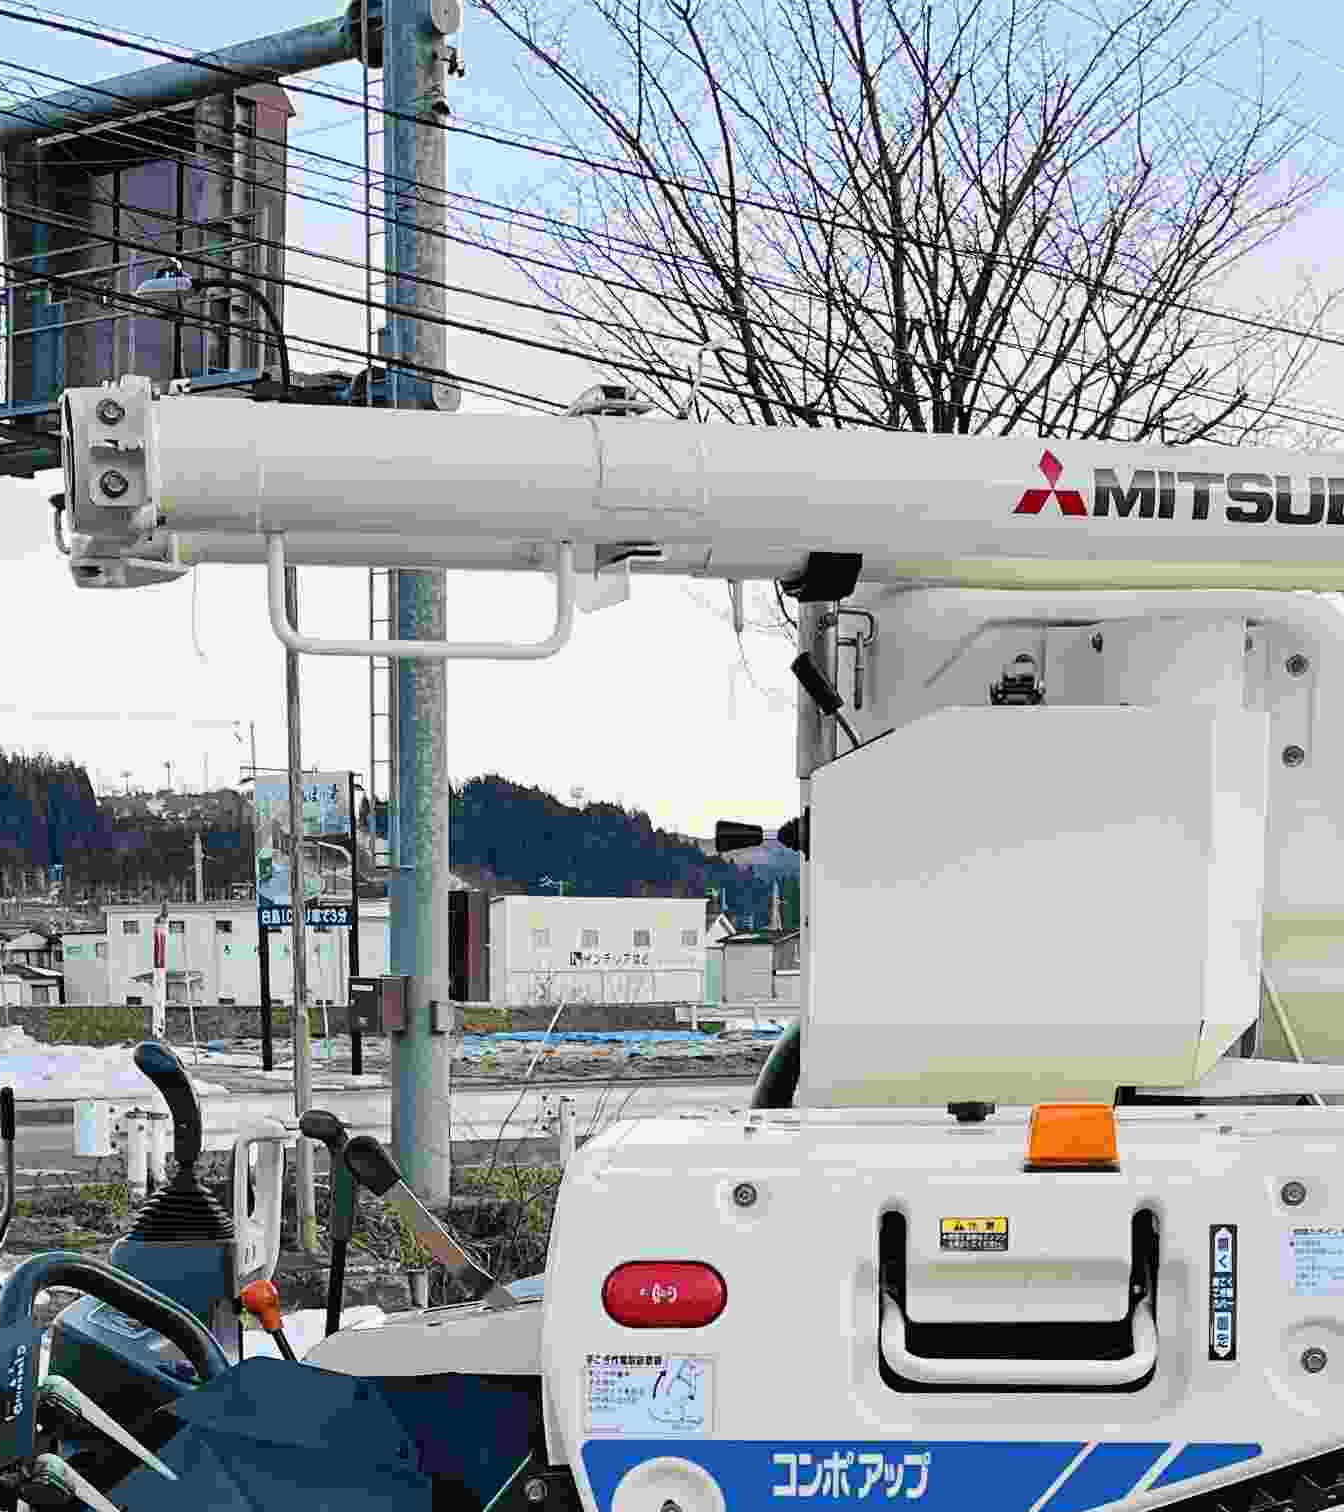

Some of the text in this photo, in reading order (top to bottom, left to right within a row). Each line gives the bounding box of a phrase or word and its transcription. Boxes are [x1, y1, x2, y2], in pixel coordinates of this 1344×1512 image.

[771, 1450, 932, 1499] コンポアップ
